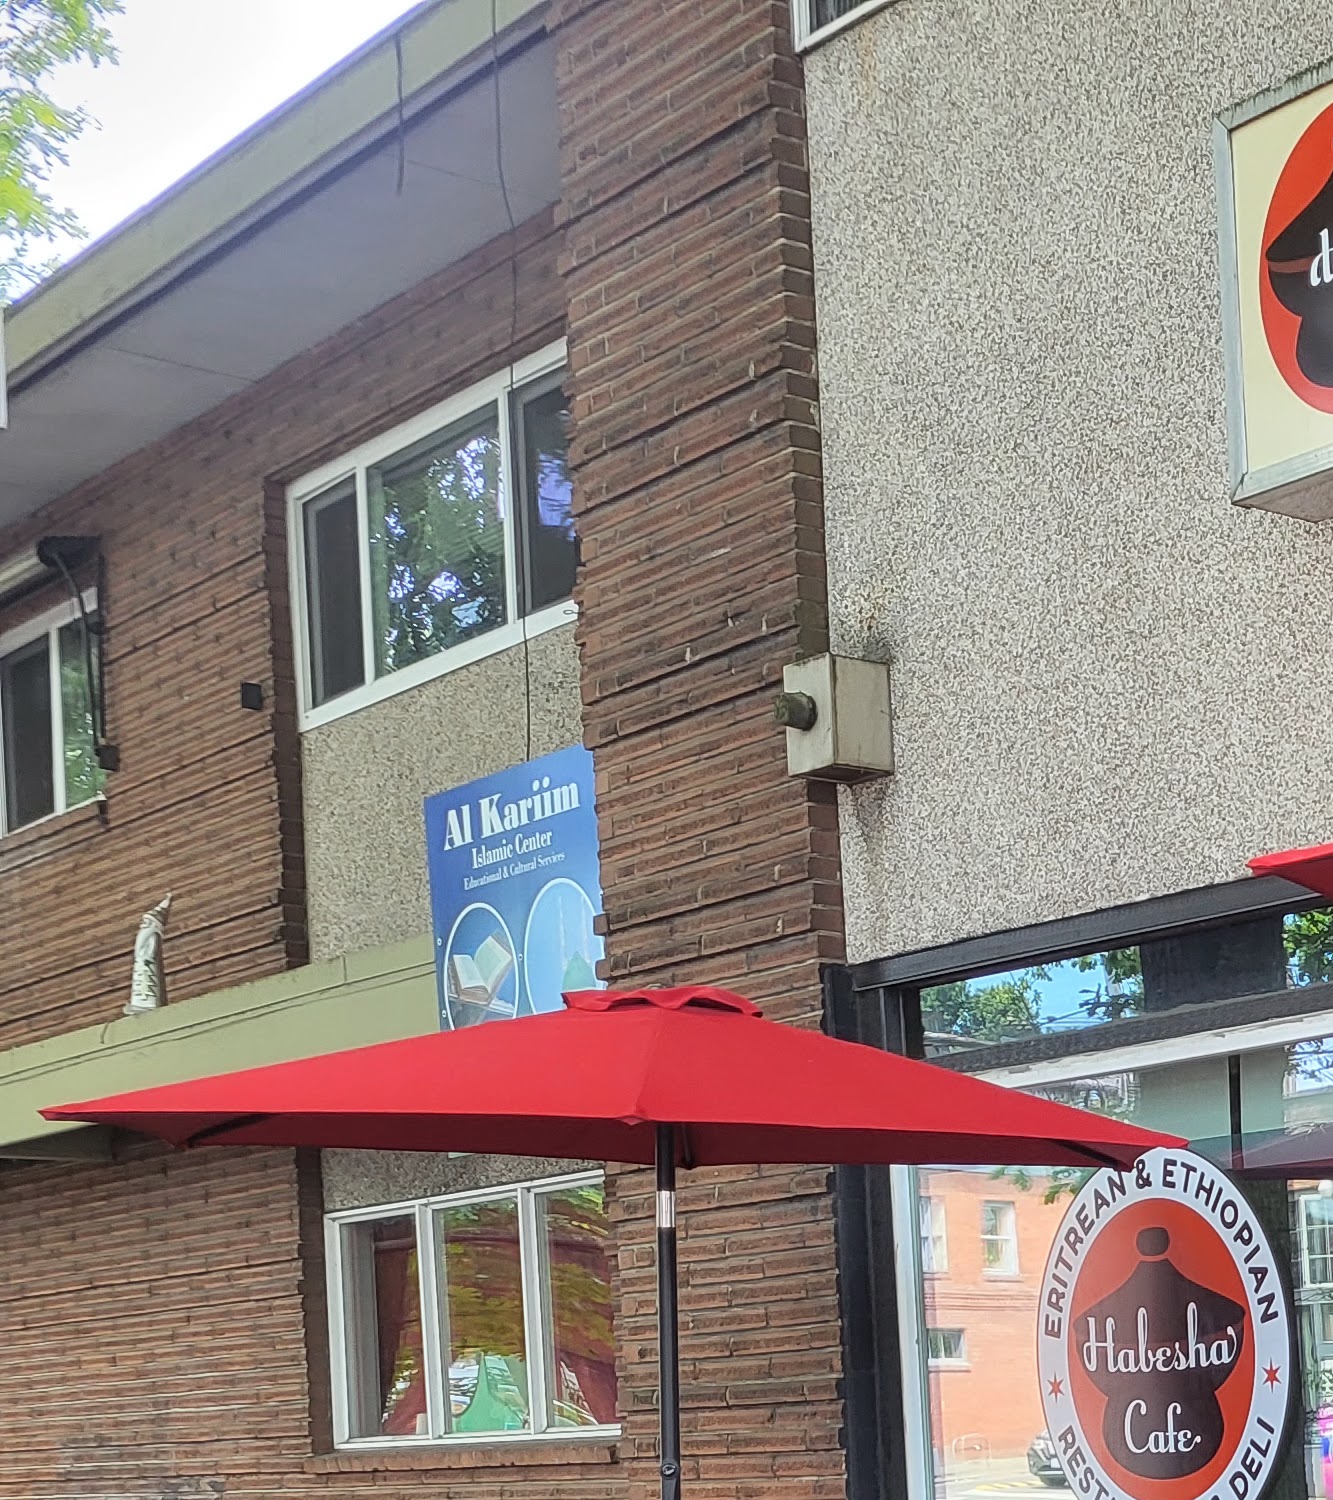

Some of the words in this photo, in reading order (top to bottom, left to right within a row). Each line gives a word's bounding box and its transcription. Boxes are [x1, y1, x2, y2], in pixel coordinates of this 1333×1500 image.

[443, 804, 473, 850] Al
[478, 776, 580, 839] Kariim
[463, 868, 502, 891] Educational
[502, 865, 509, 880] &
[510, 857, 537, 877] Cultural
[538, 850, 566, 869] Services
[471, 840, 514, 869] Islamic
[514, 831, 553, 855] Center
[1045, 1169, 1127, 1339] ERITREAN
[1135, 1158, 1152, 1189] &
[1162, 1158, 1279, 1324] ETHIOPIAN
[1083, 1300, 1238, 1373] Habesha
[1124, 1399, 1202, 1454] Cafe
